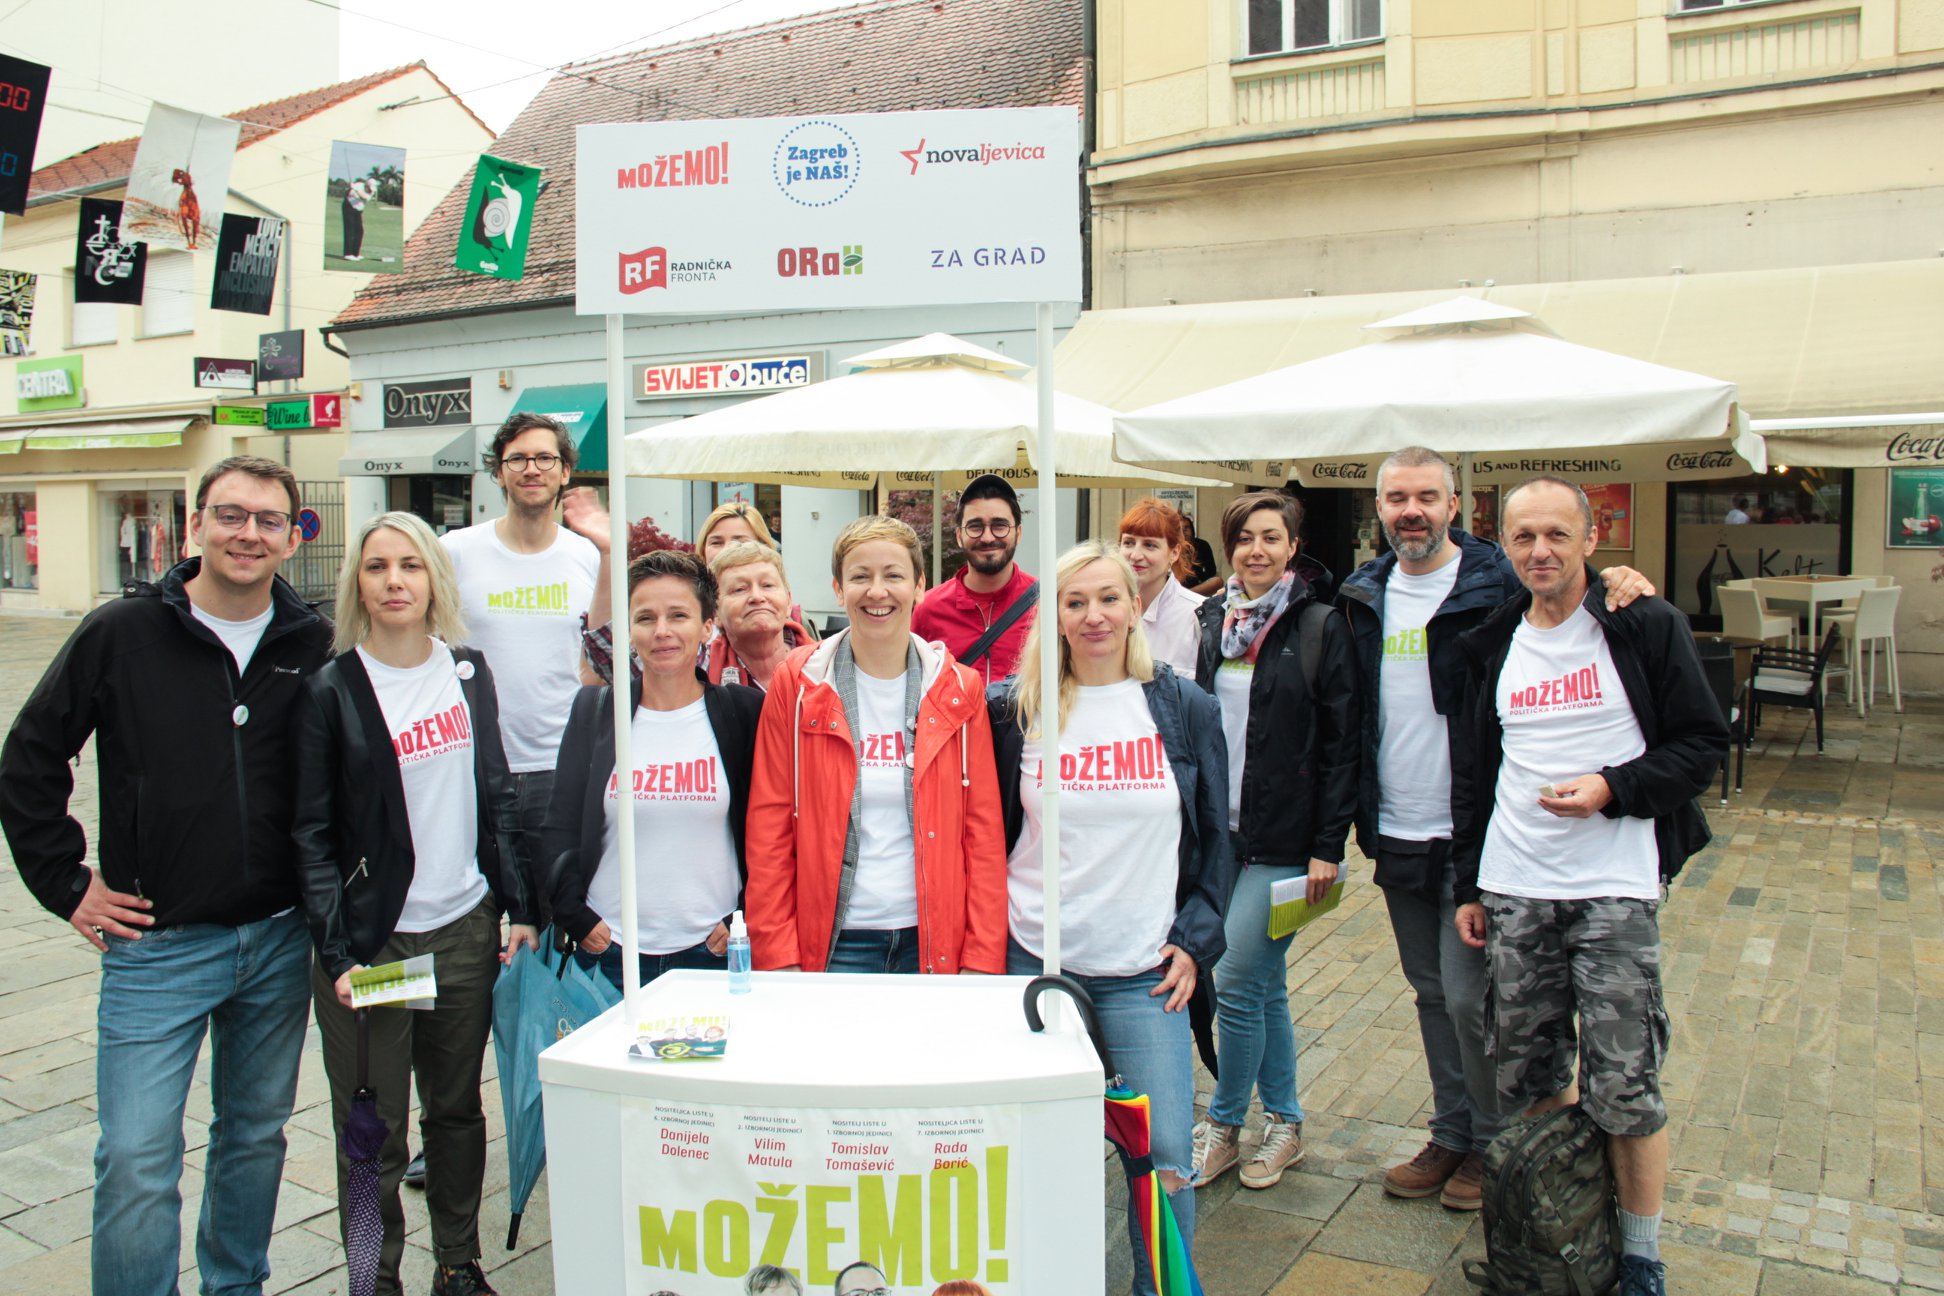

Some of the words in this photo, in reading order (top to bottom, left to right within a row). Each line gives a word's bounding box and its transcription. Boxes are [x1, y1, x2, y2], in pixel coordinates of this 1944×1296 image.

[787, 144, 848, 165] Zagreb
[617, 141, 729, 189] MOŽEMO!
[786, 166, 802, 185] je
[805, 161, 849, 180] NAŠ!
[257, 217, 284, 239] LOVE
[244, 233, 281, 258] MERCY
[229, 251, 278, 277] EMPATHY
[670, 257, 733, 273] RADNIČKA
[931, 249, 963, 268] ZA
[973, 246, 1046, 266] GRAD
[624, 255, 662, 286] RF
[670, 271, 717, 283] FRONTA
[646, 365, 723, 392] SVIJET
[725, 359, 807, 388] Obuće
[384, 386, 471, 423] Onyx
[271, 407, 301, 425] Wine
[364, 461, 403, 472] Onyx
[438, 459, 470, 468] Onyx
[1312, 462, 1368, 479] Coca-Cola
[1520, 459, 1621, 472] REFRESHING
[487, 581, 568, 610] MOŽEMO!
[1510, 662, 1602, 709] MOŽEMO!
[1510, 704, 1549, 716] POLITIČKA
[1552, 700, 1604, 712] PLATFORMA
[1037, 733, 1166, 780] OŽEMO!
[1037, 783, 1094, 792] PTIČKA
[1099, 782, 1166, 791] PLATFORMA
[610, 793, 657, 801] POIČKA
[660, 794, 717, 802] PLATFORMA
[660, 1128, 709, 1145] Danijela
[754, 1137, 786, 1151] Vilim
[661, 1143, 709, 1160] Dolenec
[831, 1141, 889, 1155] Tomislav
[934, 1141, 968, 1154] Rada
[747, 1153, 793, 1168] Matula
[825, 1158, 895, 1171] Tomašević
[934, 1156, 969, 1170] Borić
[638, 1145, 1009, 1287] MOŽEMO!
